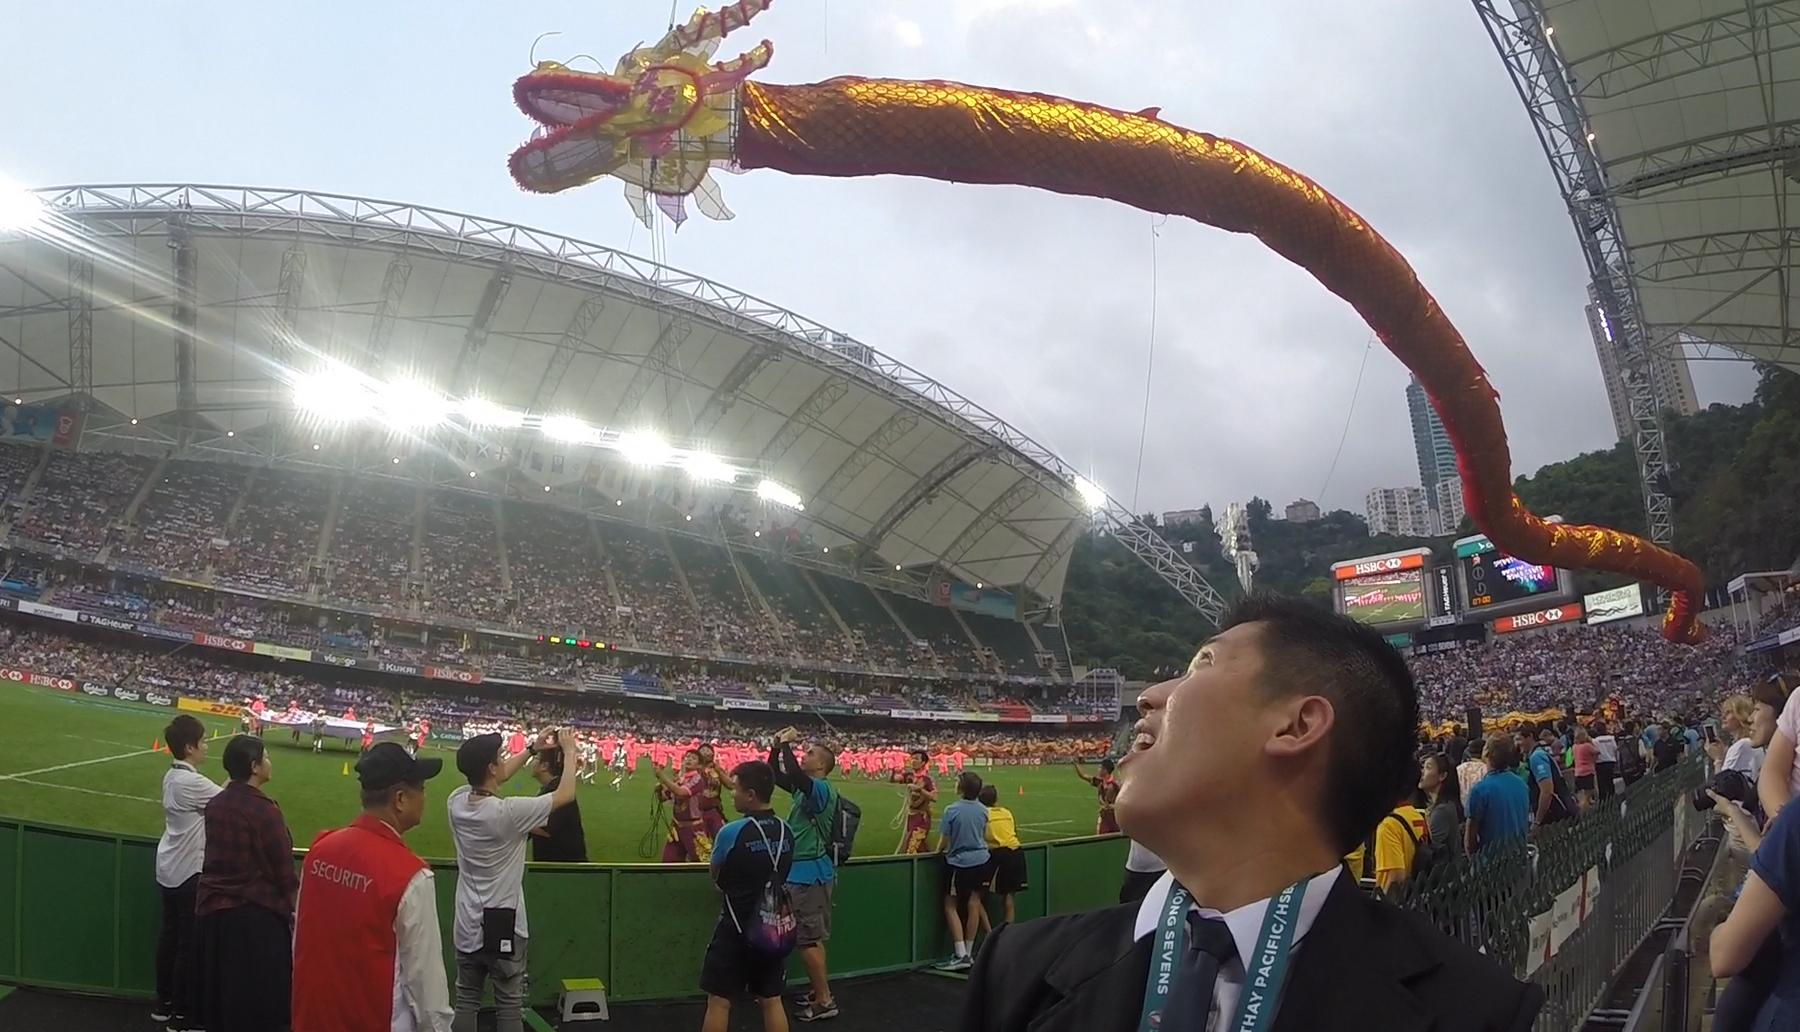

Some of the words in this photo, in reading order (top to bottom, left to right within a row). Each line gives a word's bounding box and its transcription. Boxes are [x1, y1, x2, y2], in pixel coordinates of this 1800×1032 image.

[1356, 560, 1386, 575] HSBC
[1512, 611, 1545, 628] HSBC
[203, 634, 231, 648] HSBC
[324, 653, 356, 667] viagogo
[386, 663, 417, 674] KUKRI
[433, 667, 458, 680] HSBC
[30, 674, 58, 688] HSBC
[211, 703, 241, 716] DH
[311, 858, 374, 893] SECURITY
[1157, 930, 1176, 995] SEVENS
[1240, 992, 1264, 1032] THAY
